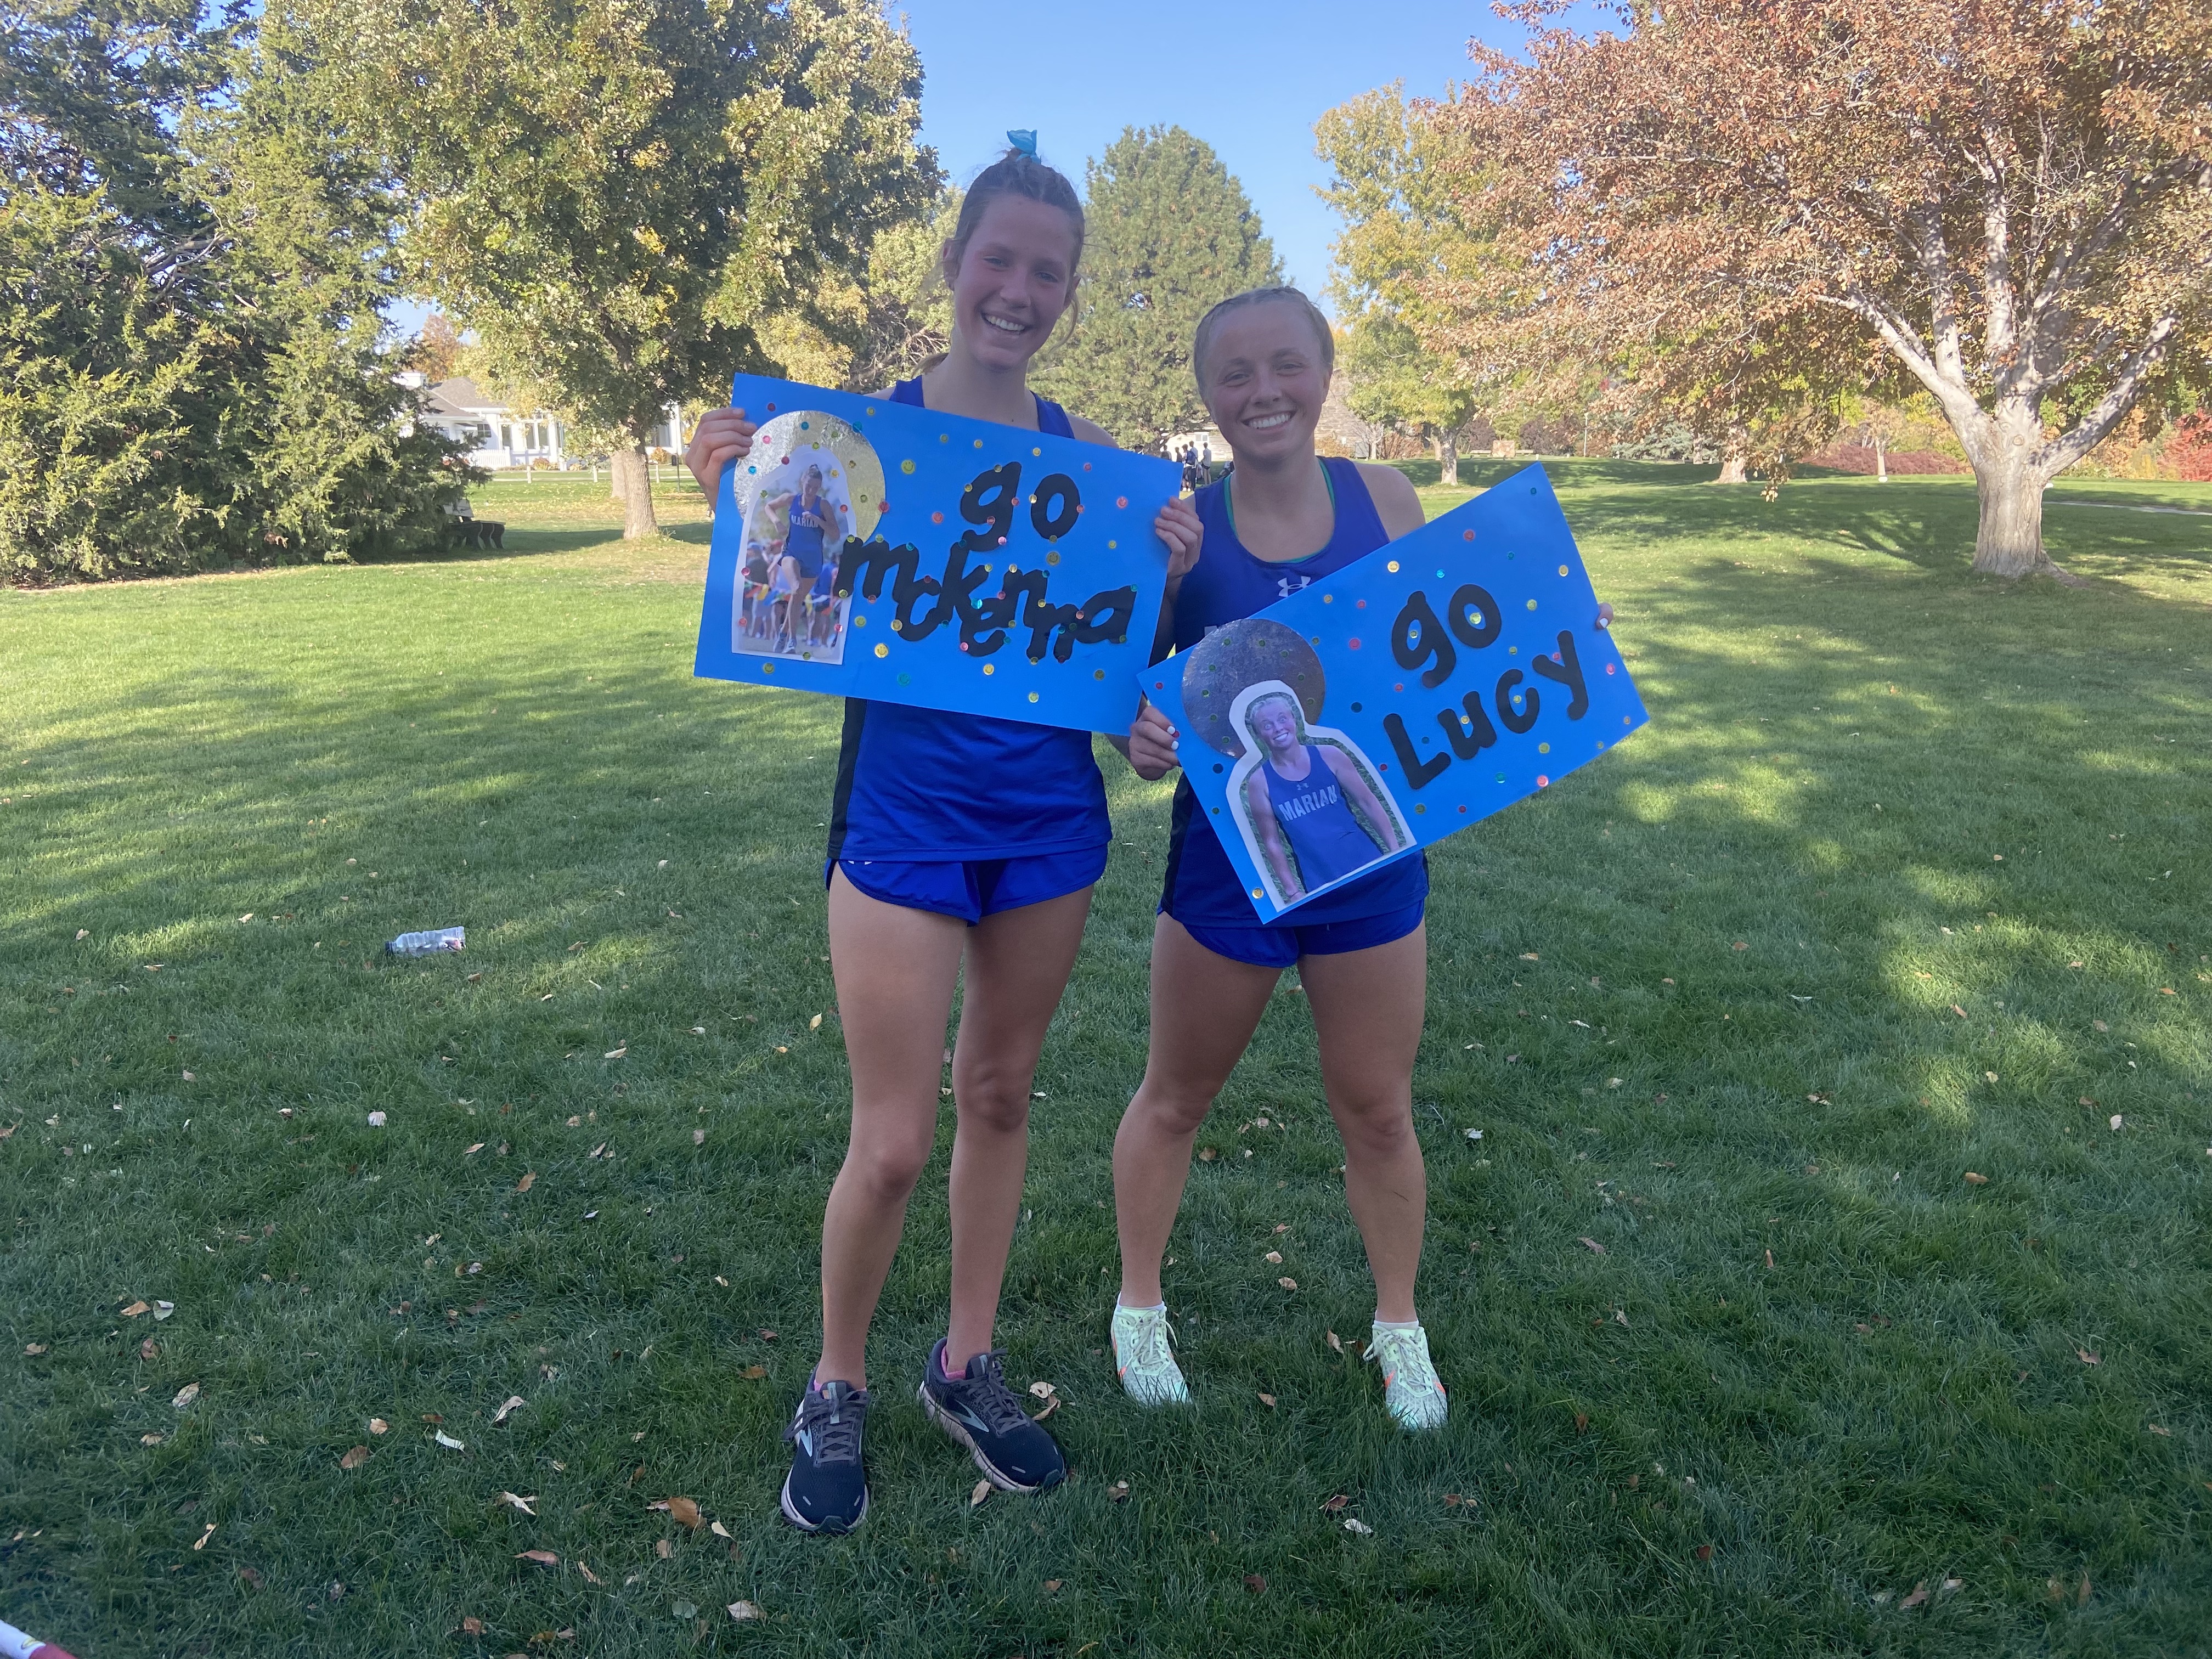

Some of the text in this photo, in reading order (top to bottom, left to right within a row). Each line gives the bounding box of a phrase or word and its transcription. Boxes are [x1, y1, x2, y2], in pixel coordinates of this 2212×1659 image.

[960, 461, 1081, 552] go
[1392, 584, 1502, 688] go
[1383, 630, 1589, 789] Lucy
[1278, 785, 1337, 821] MARIAN
